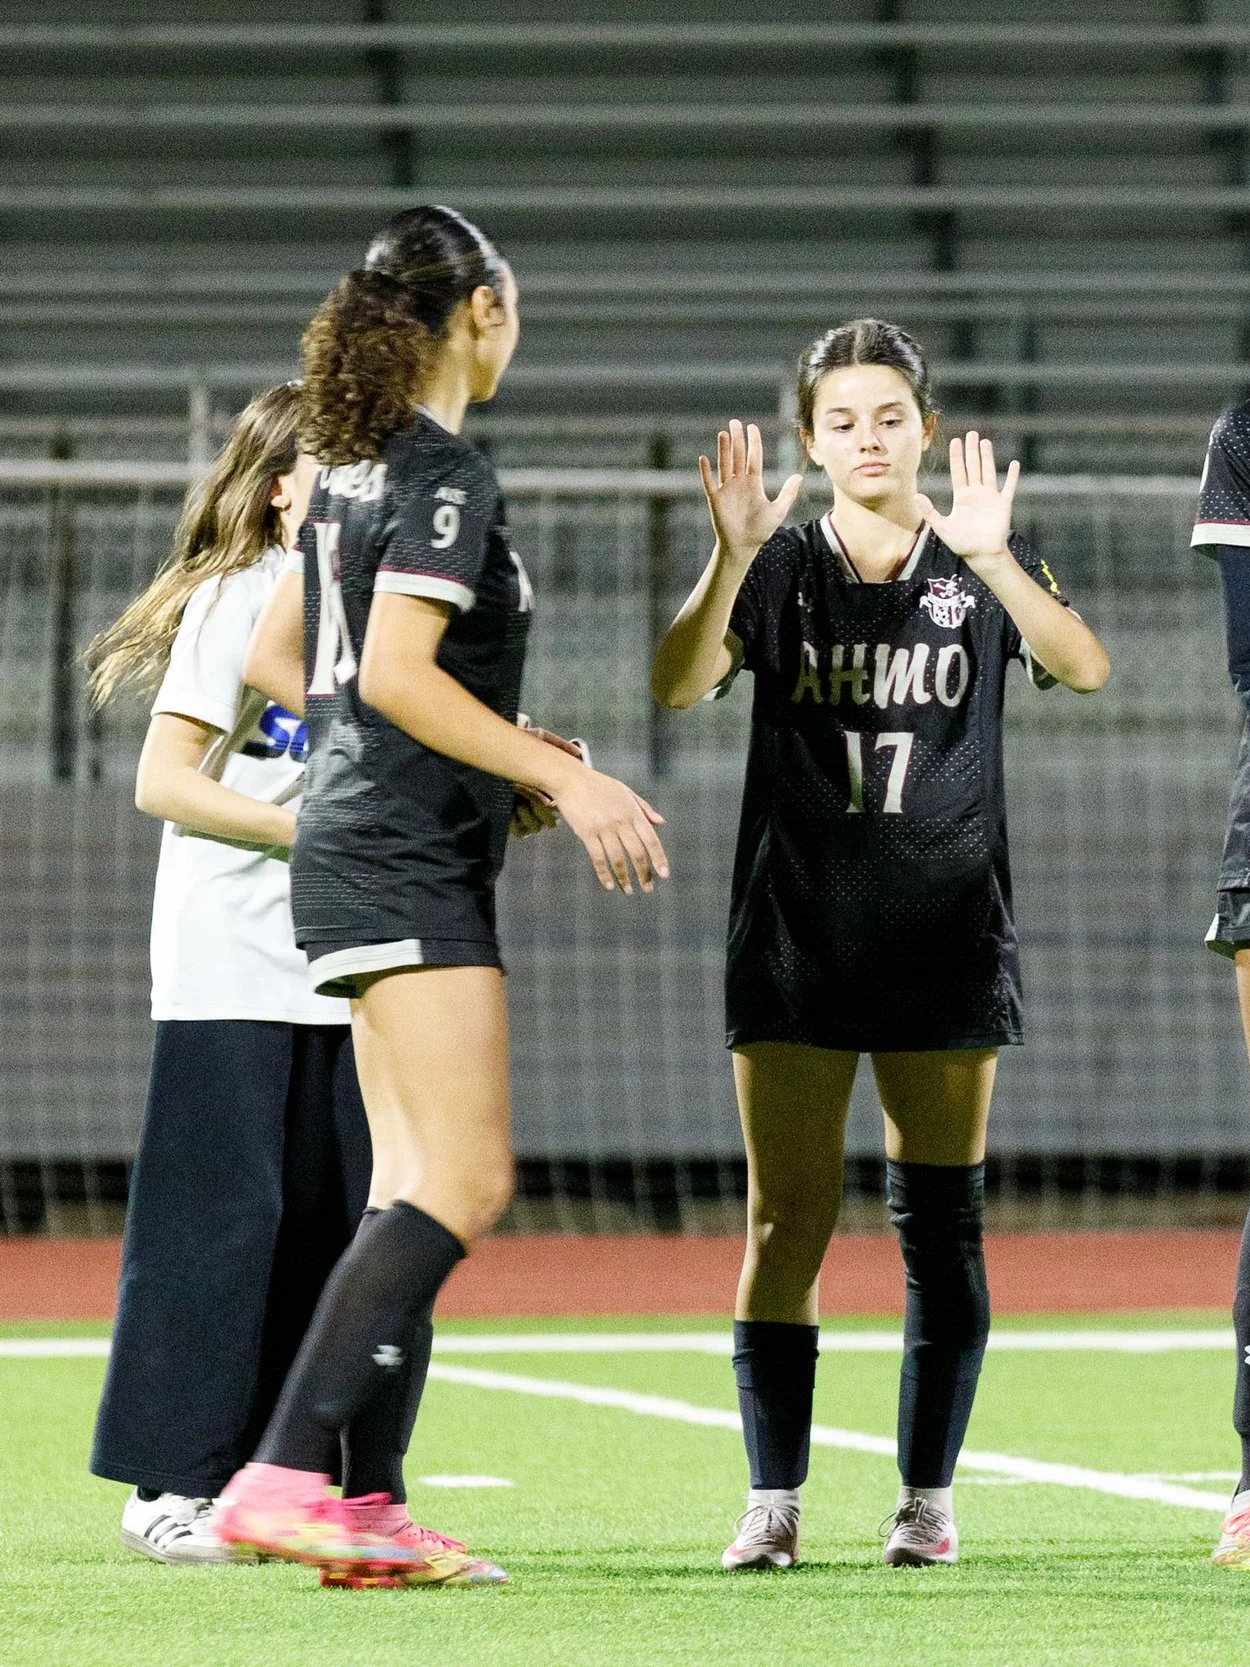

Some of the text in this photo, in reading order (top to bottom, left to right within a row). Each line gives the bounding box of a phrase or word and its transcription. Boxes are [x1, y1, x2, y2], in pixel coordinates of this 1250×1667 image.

[430, 505, 461, 549] 9
[792, 642, 969, 710] AHMO
[844, 731, 915, 813] 17
